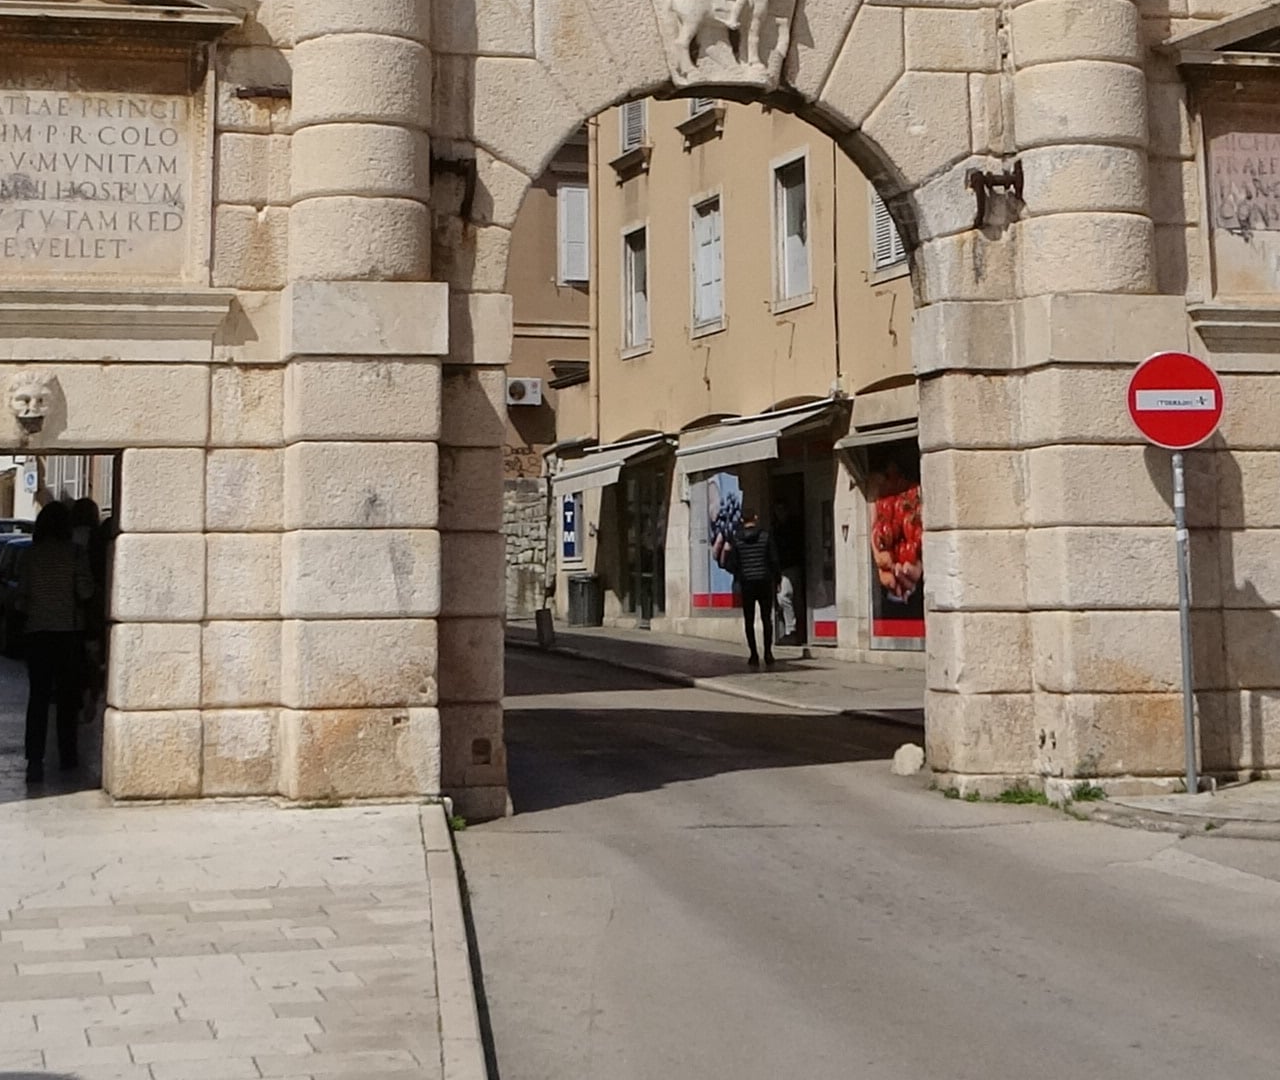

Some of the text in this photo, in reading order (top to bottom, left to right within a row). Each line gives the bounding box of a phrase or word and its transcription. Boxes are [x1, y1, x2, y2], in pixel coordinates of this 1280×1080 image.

[82, 99, 179, 121] PRINCI
[98, 126, 180, 147] COLO
[38, 152, 178, 175] MVNITAM
[16, 208, 117, 231] TVTAM
[128, 210, 183, 233] RED
[564, 493, 575, 542] ATM
